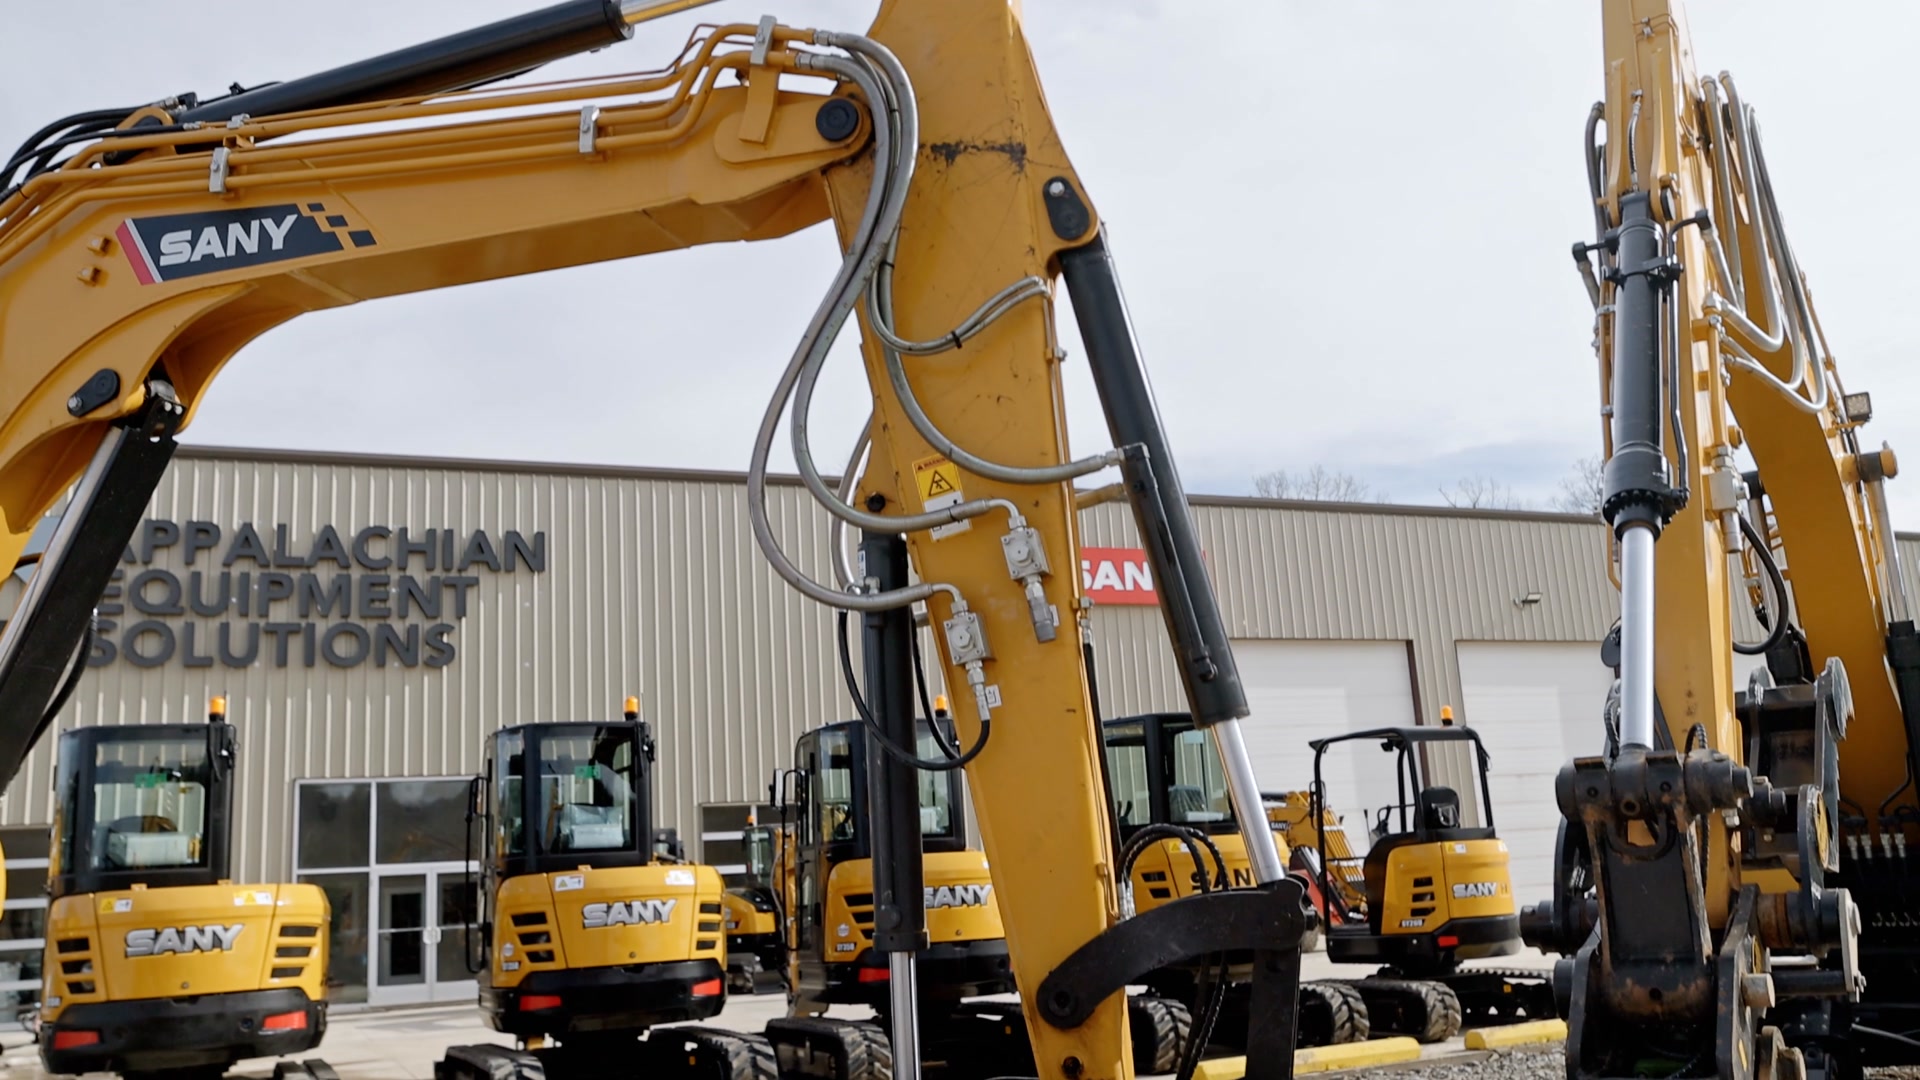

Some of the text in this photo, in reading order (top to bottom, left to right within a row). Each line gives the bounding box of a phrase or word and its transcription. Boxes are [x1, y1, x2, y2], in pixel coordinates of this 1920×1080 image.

[159, 214, 298, 266] SANY
[87, 619, 456, 668] SOLUTIONS
[1453, 882, 1497, 899] SANY
[582, 899, 677, 928] SANY
[126, 924, 244, 957] SANY
